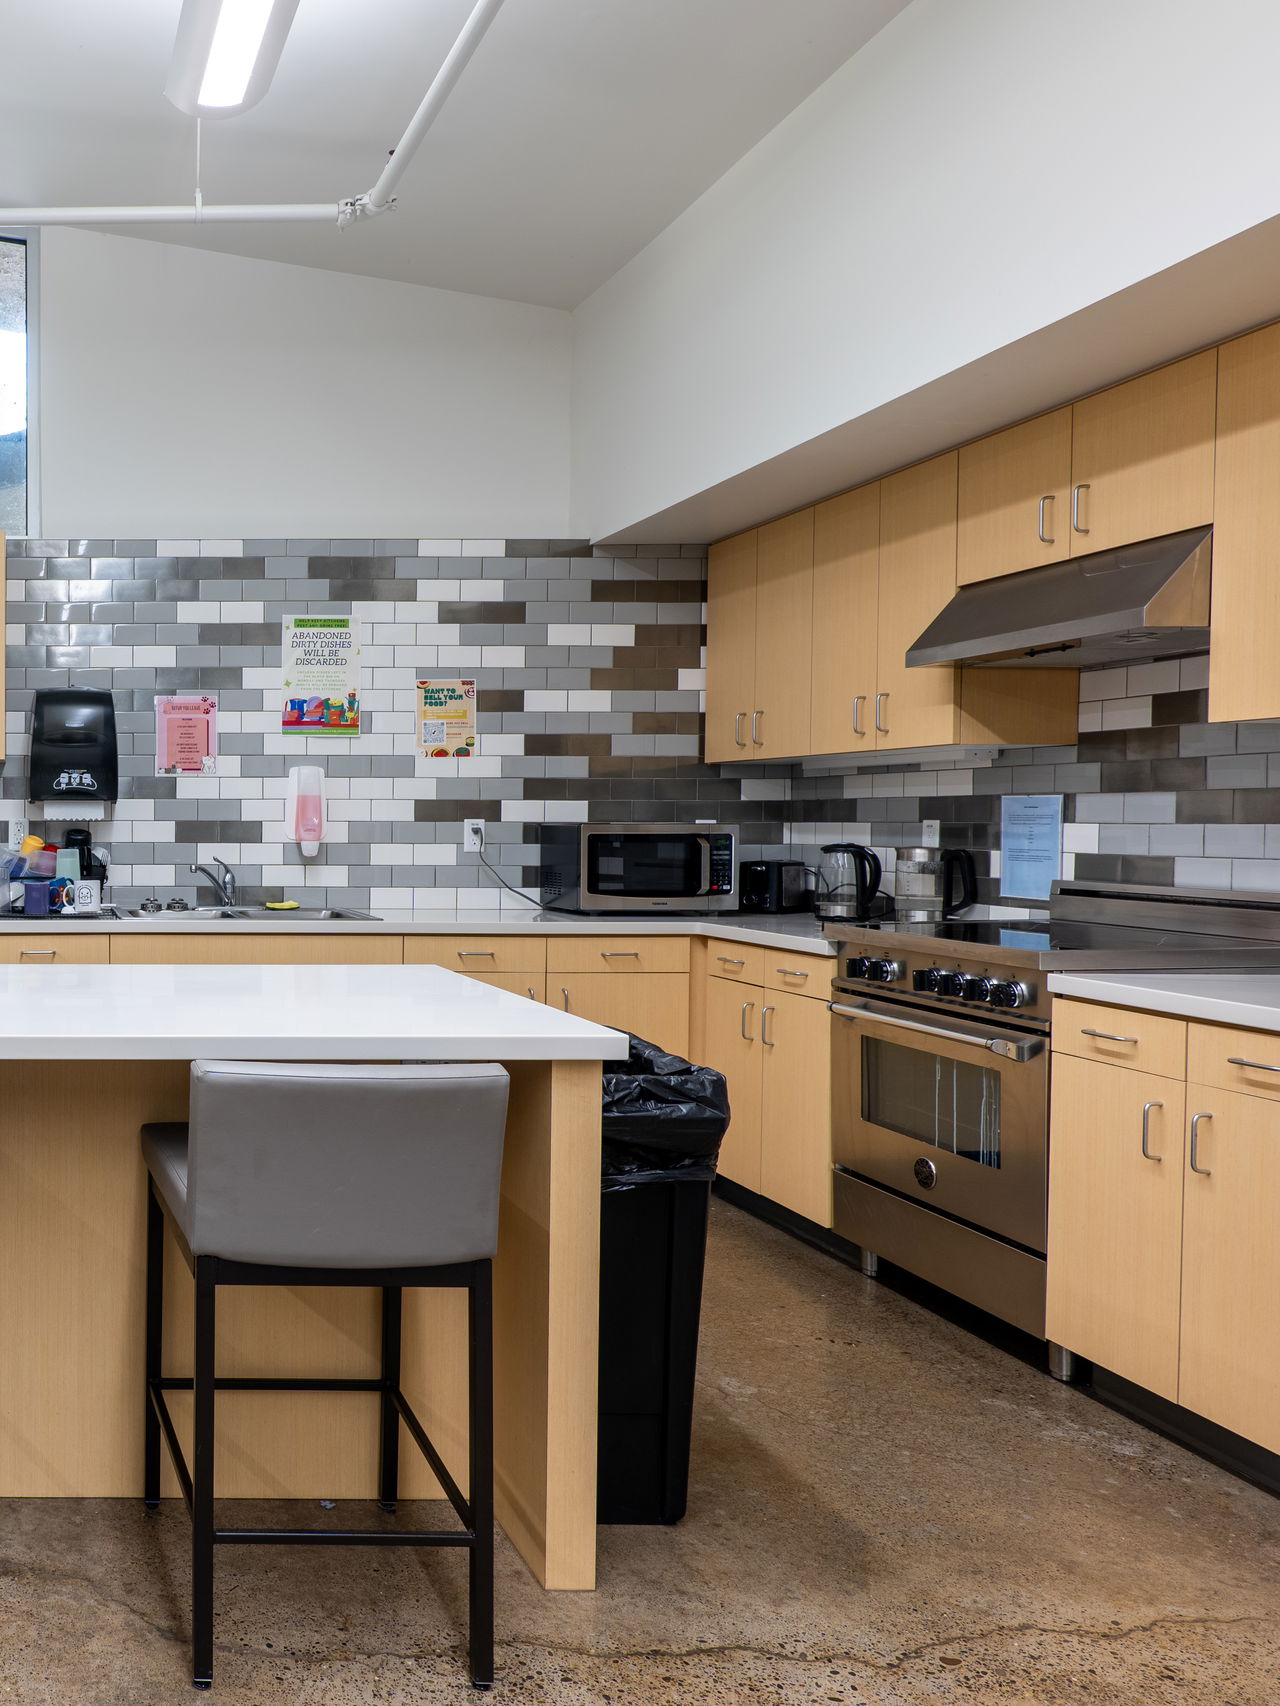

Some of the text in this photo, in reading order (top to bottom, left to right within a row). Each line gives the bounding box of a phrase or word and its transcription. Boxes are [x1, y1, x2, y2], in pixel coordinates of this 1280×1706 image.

[292, 632, 351, 640] ABANDONED
[291, 641, 352, 649] DIRTY DISHES
[304, 649, 340, 657] WILL BE
[295, 658, 348, 666] DISCARDED
